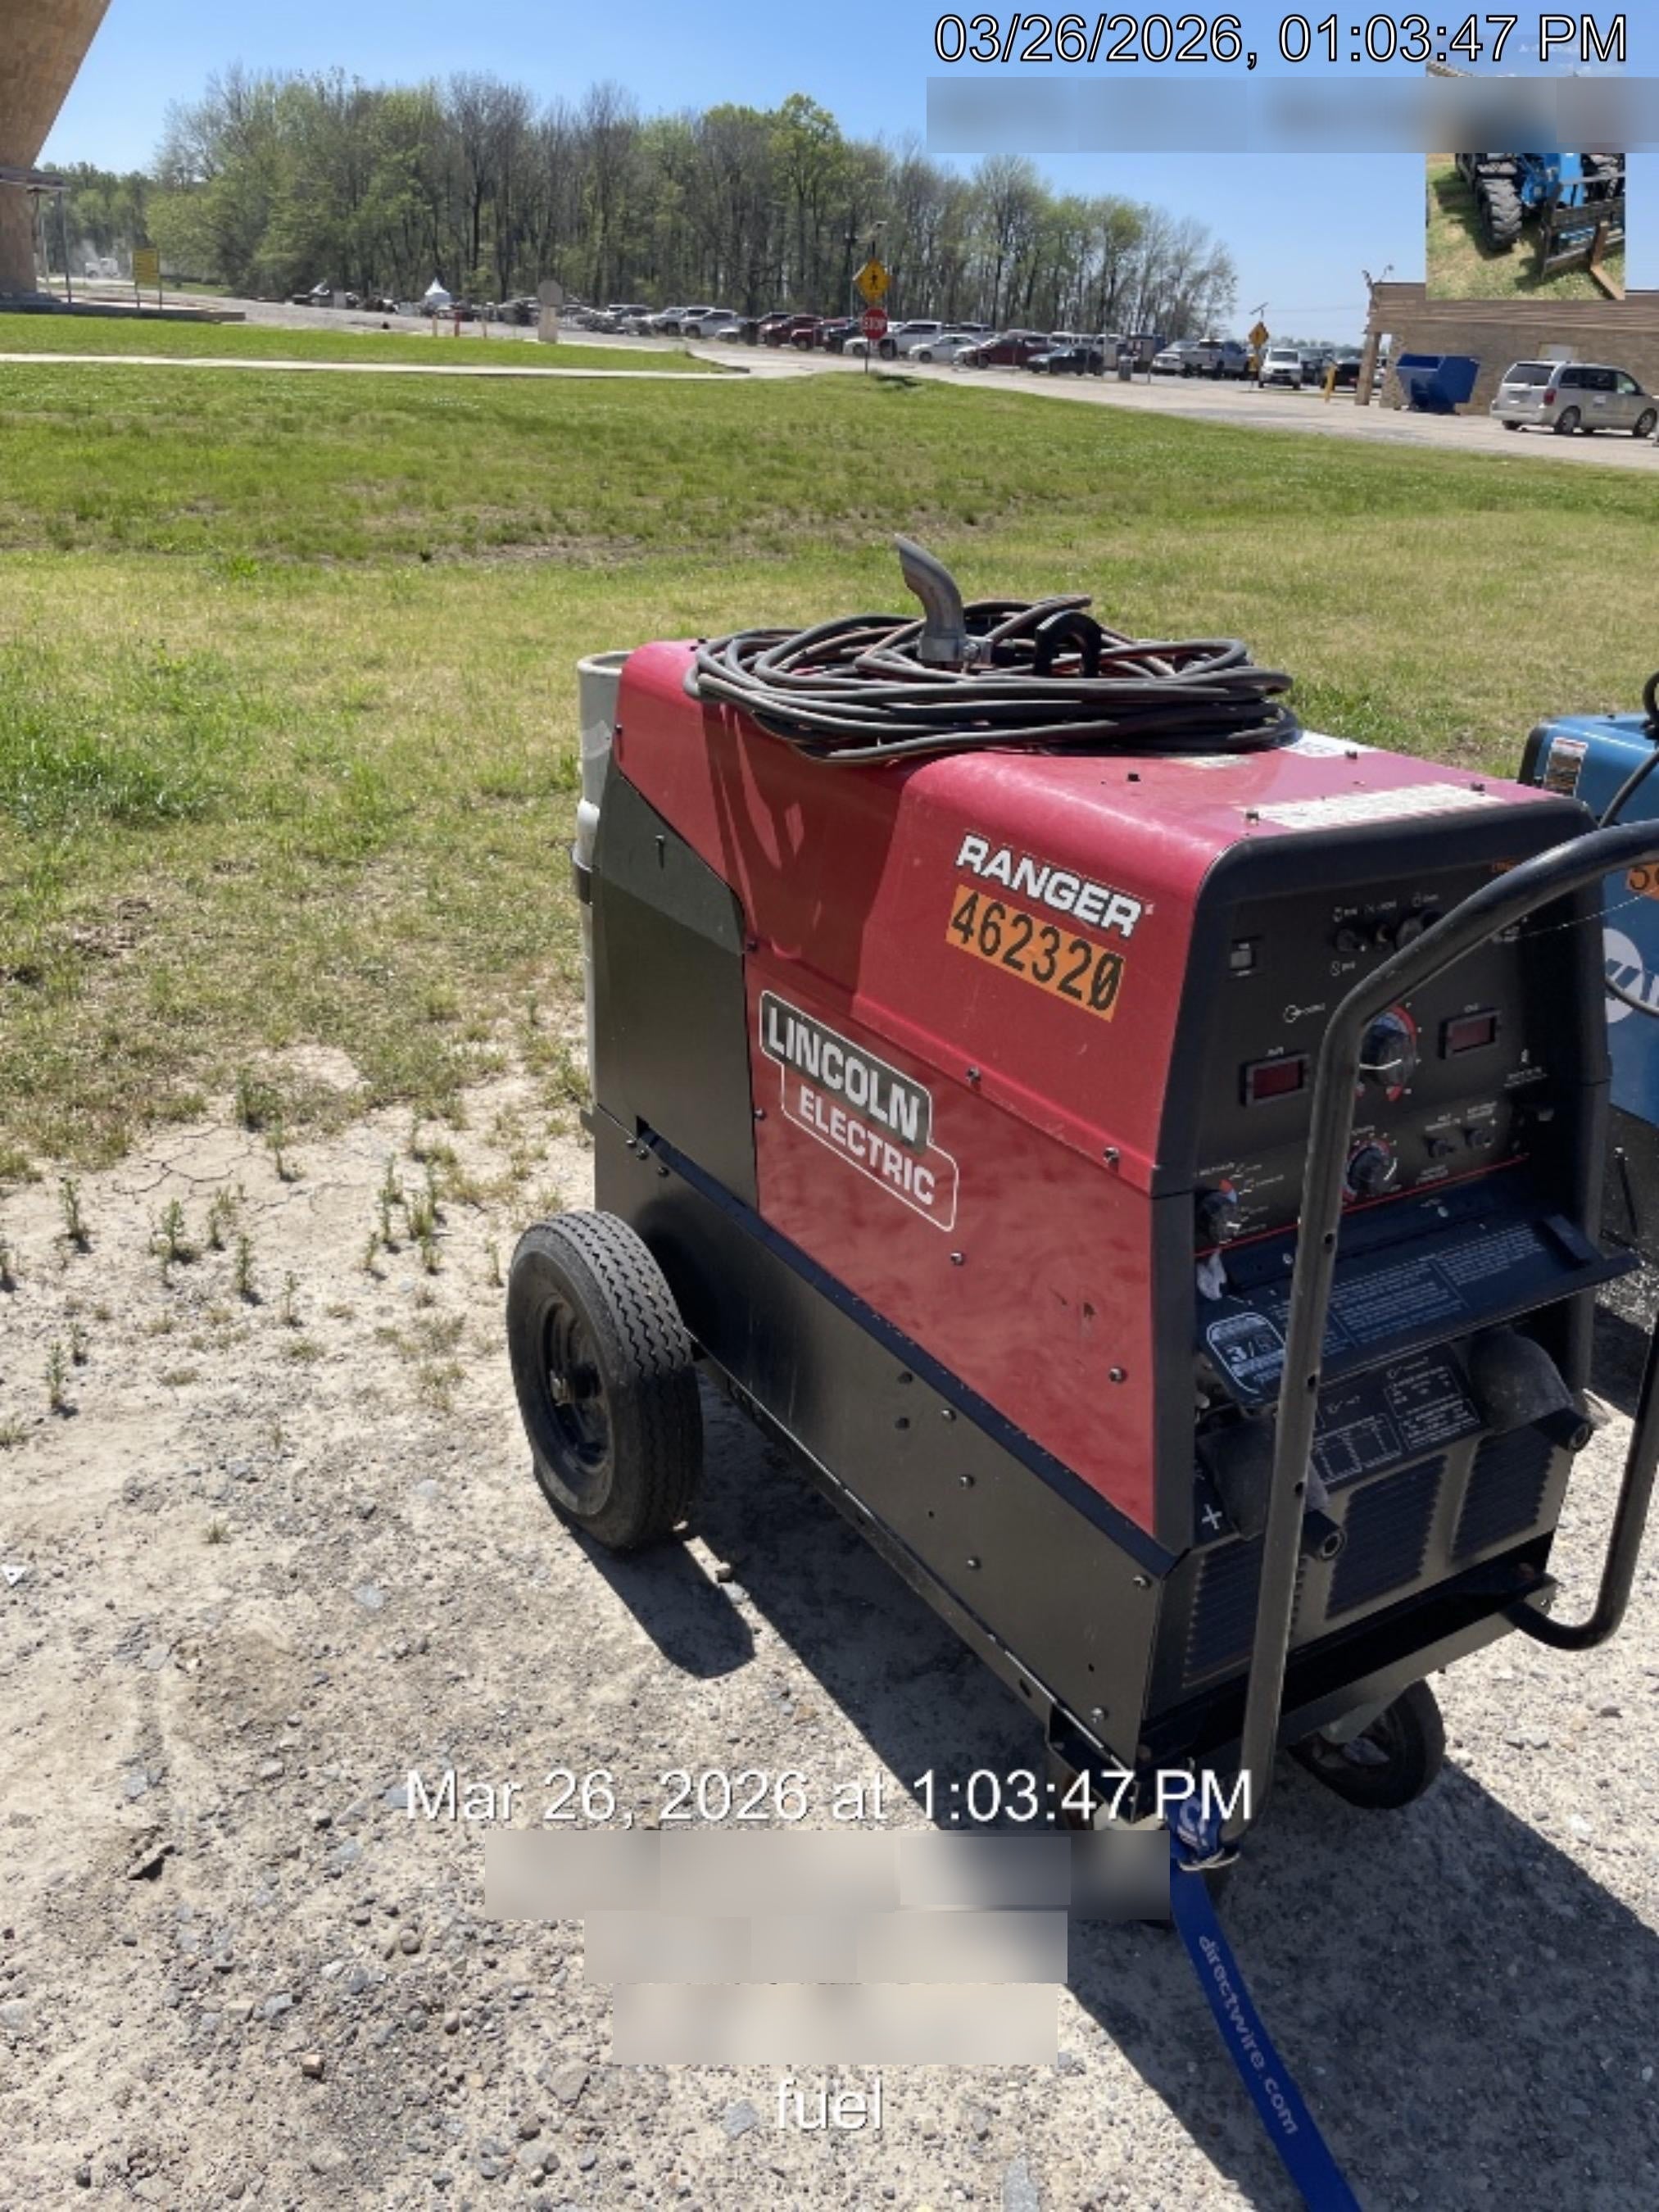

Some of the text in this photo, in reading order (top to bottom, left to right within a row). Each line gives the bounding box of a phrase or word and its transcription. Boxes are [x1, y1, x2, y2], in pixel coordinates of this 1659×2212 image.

[954, 832, 1142, 939] RANGER
[950, 890, 1124, 1012] 462320
[768, 1006, 921, 1142] LINCOLN
[798, 1085, 936, 1206] ELECTRIC
